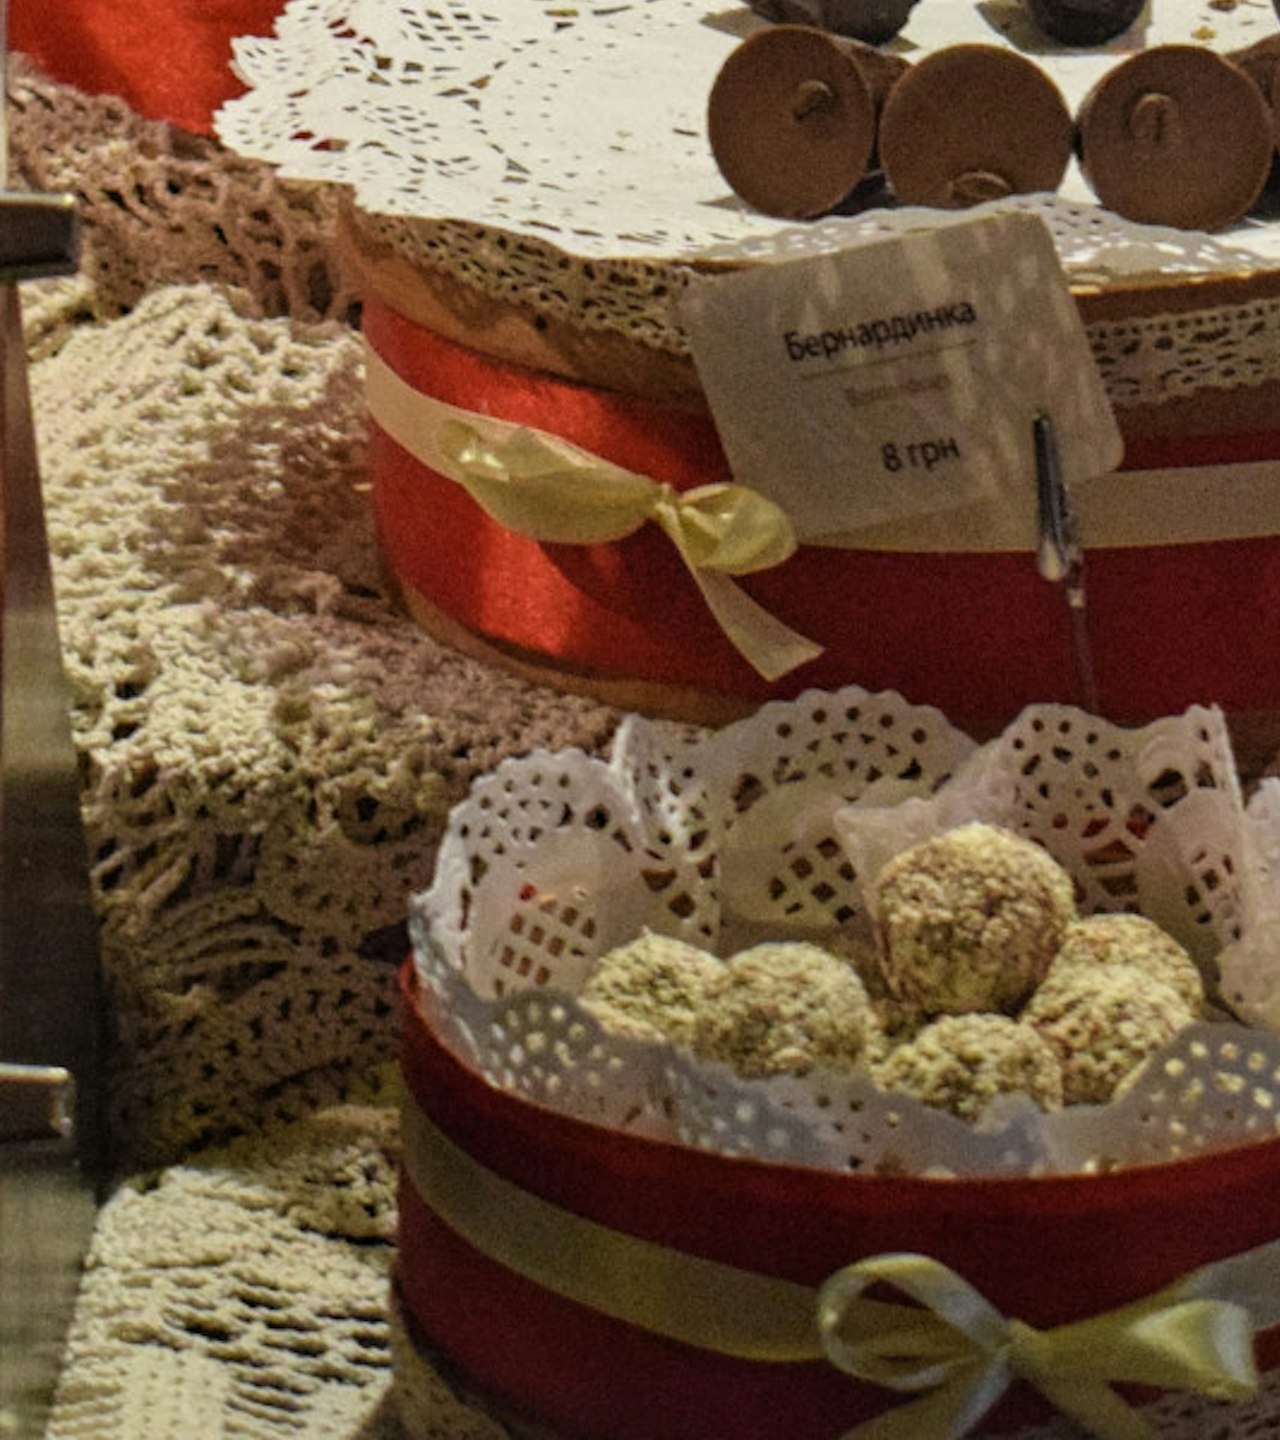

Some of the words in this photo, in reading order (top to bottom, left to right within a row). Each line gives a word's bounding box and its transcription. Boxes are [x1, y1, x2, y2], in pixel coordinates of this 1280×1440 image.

[784, 301, 976, 360] Бернардинка
[881, 441, 902, 474] 8
[906, 436, 962, 472] грн
